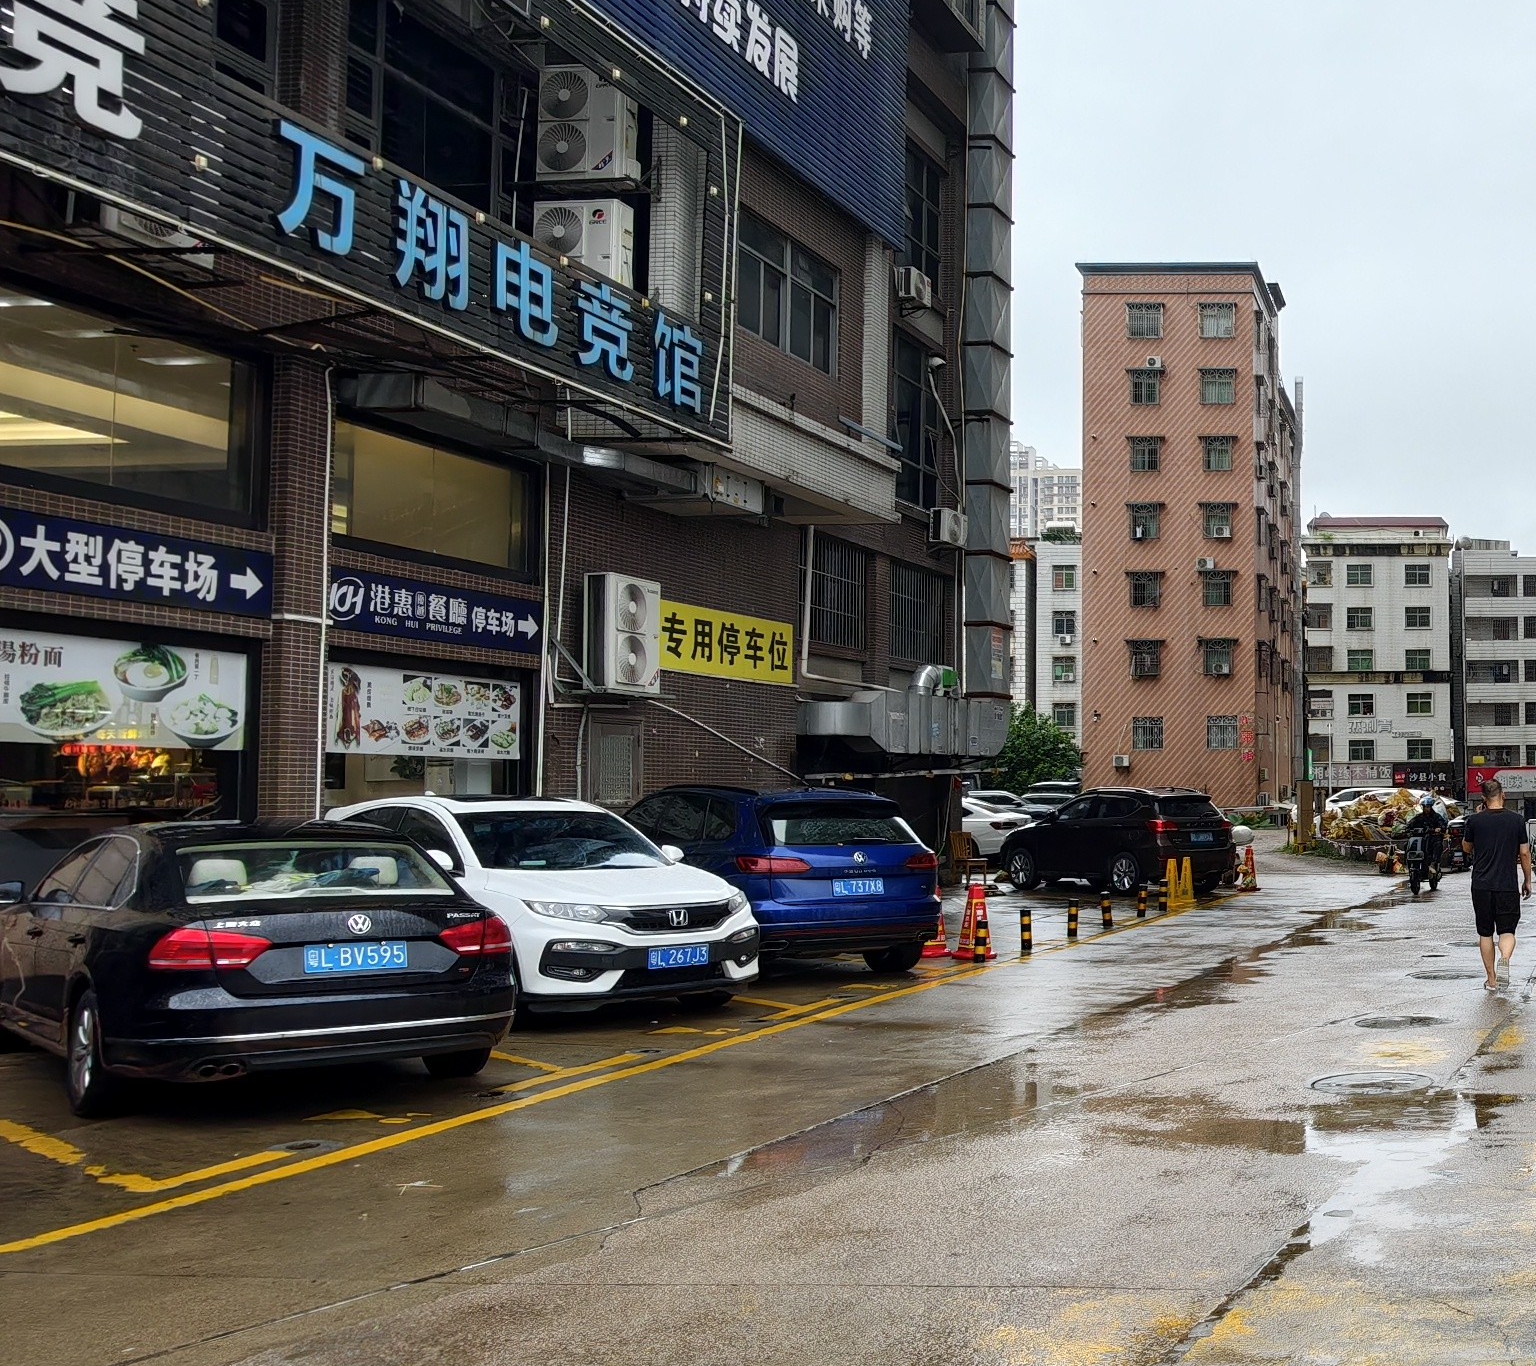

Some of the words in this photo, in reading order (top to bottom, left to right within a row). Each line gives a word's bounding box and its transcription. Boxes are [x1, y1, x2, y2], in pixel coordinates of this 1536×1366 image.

[273, 118, 703, 415] 万翔电竞馆
[19, 524, 219, 602] 大型停车场
[374, 615, 398, 626] KONG
[405, 619, 419, 629] HUI
[426, 623, 463, 635] PRIVILEGE
[661, 611, 789, 672] 专用停车位
